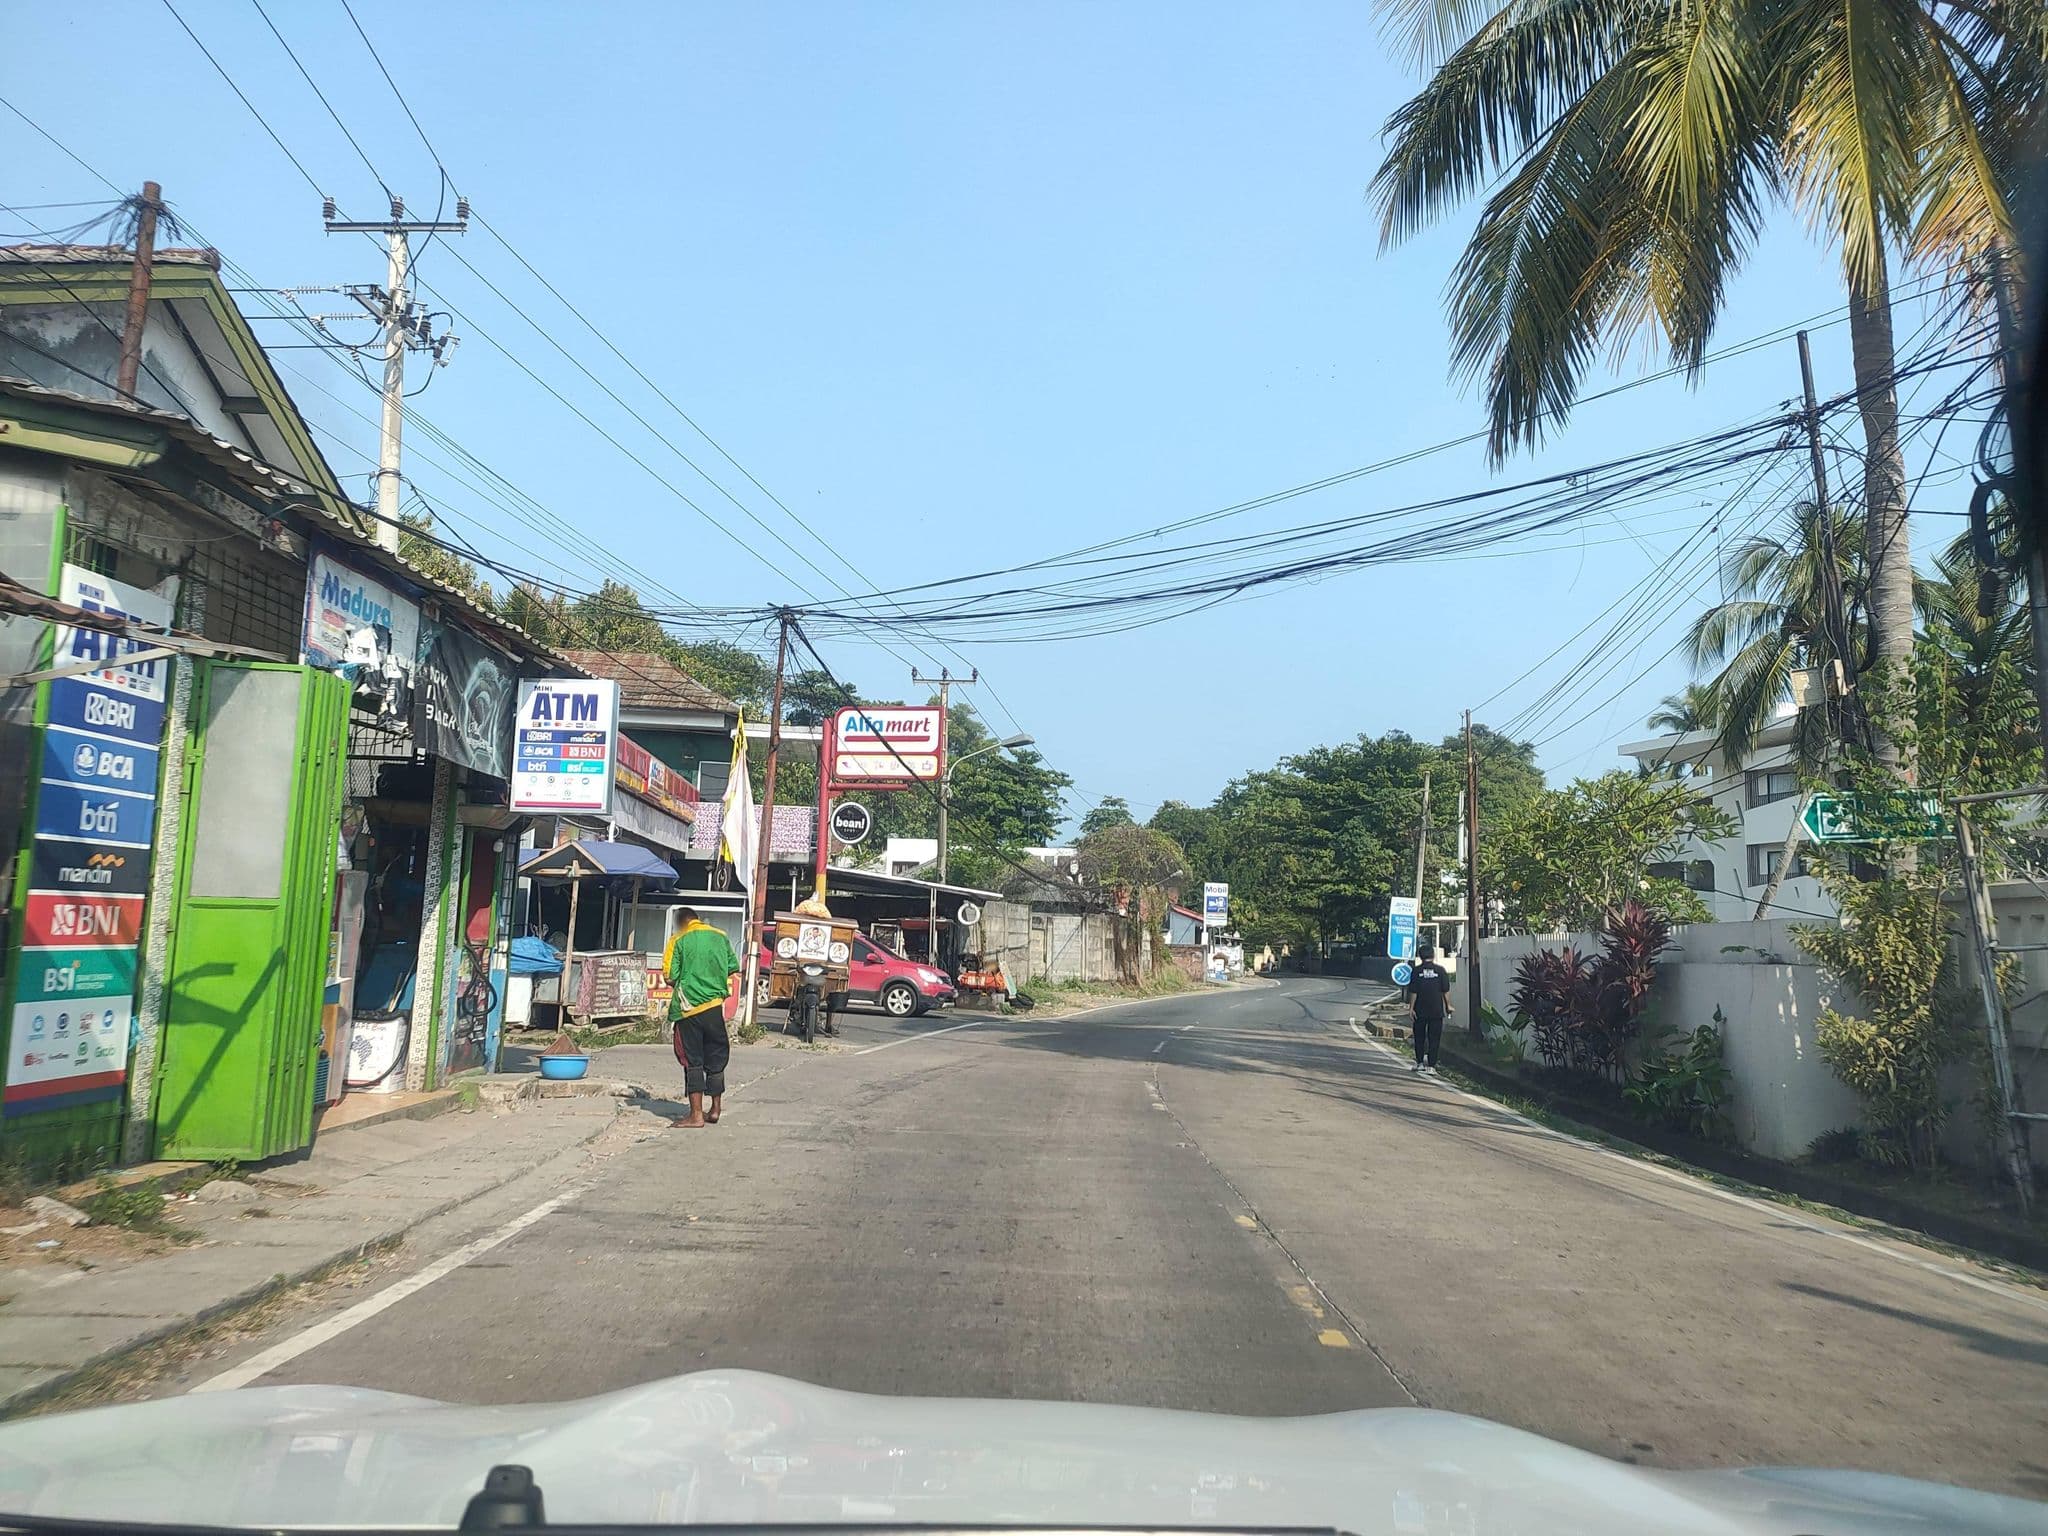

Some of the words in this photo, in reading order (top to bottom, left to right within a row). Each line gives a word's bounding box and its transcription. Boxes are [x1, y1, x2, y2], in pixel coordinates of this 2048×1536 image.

[321, 571, 391, 628] Madura
[106, 701, 136, 730] BRI
[531, 693, 598, 721] ATM
[96, 752, 134, 780] BCA
[580, 747, 602, 757] BNI
[79, 799, 120, 834] btn
[836, 816, 865, 829] bean!
[58, 865, 112, 885] mandiri
[76, 904, 121, 936] BNI
[43, 966, 75, 992] BSI
